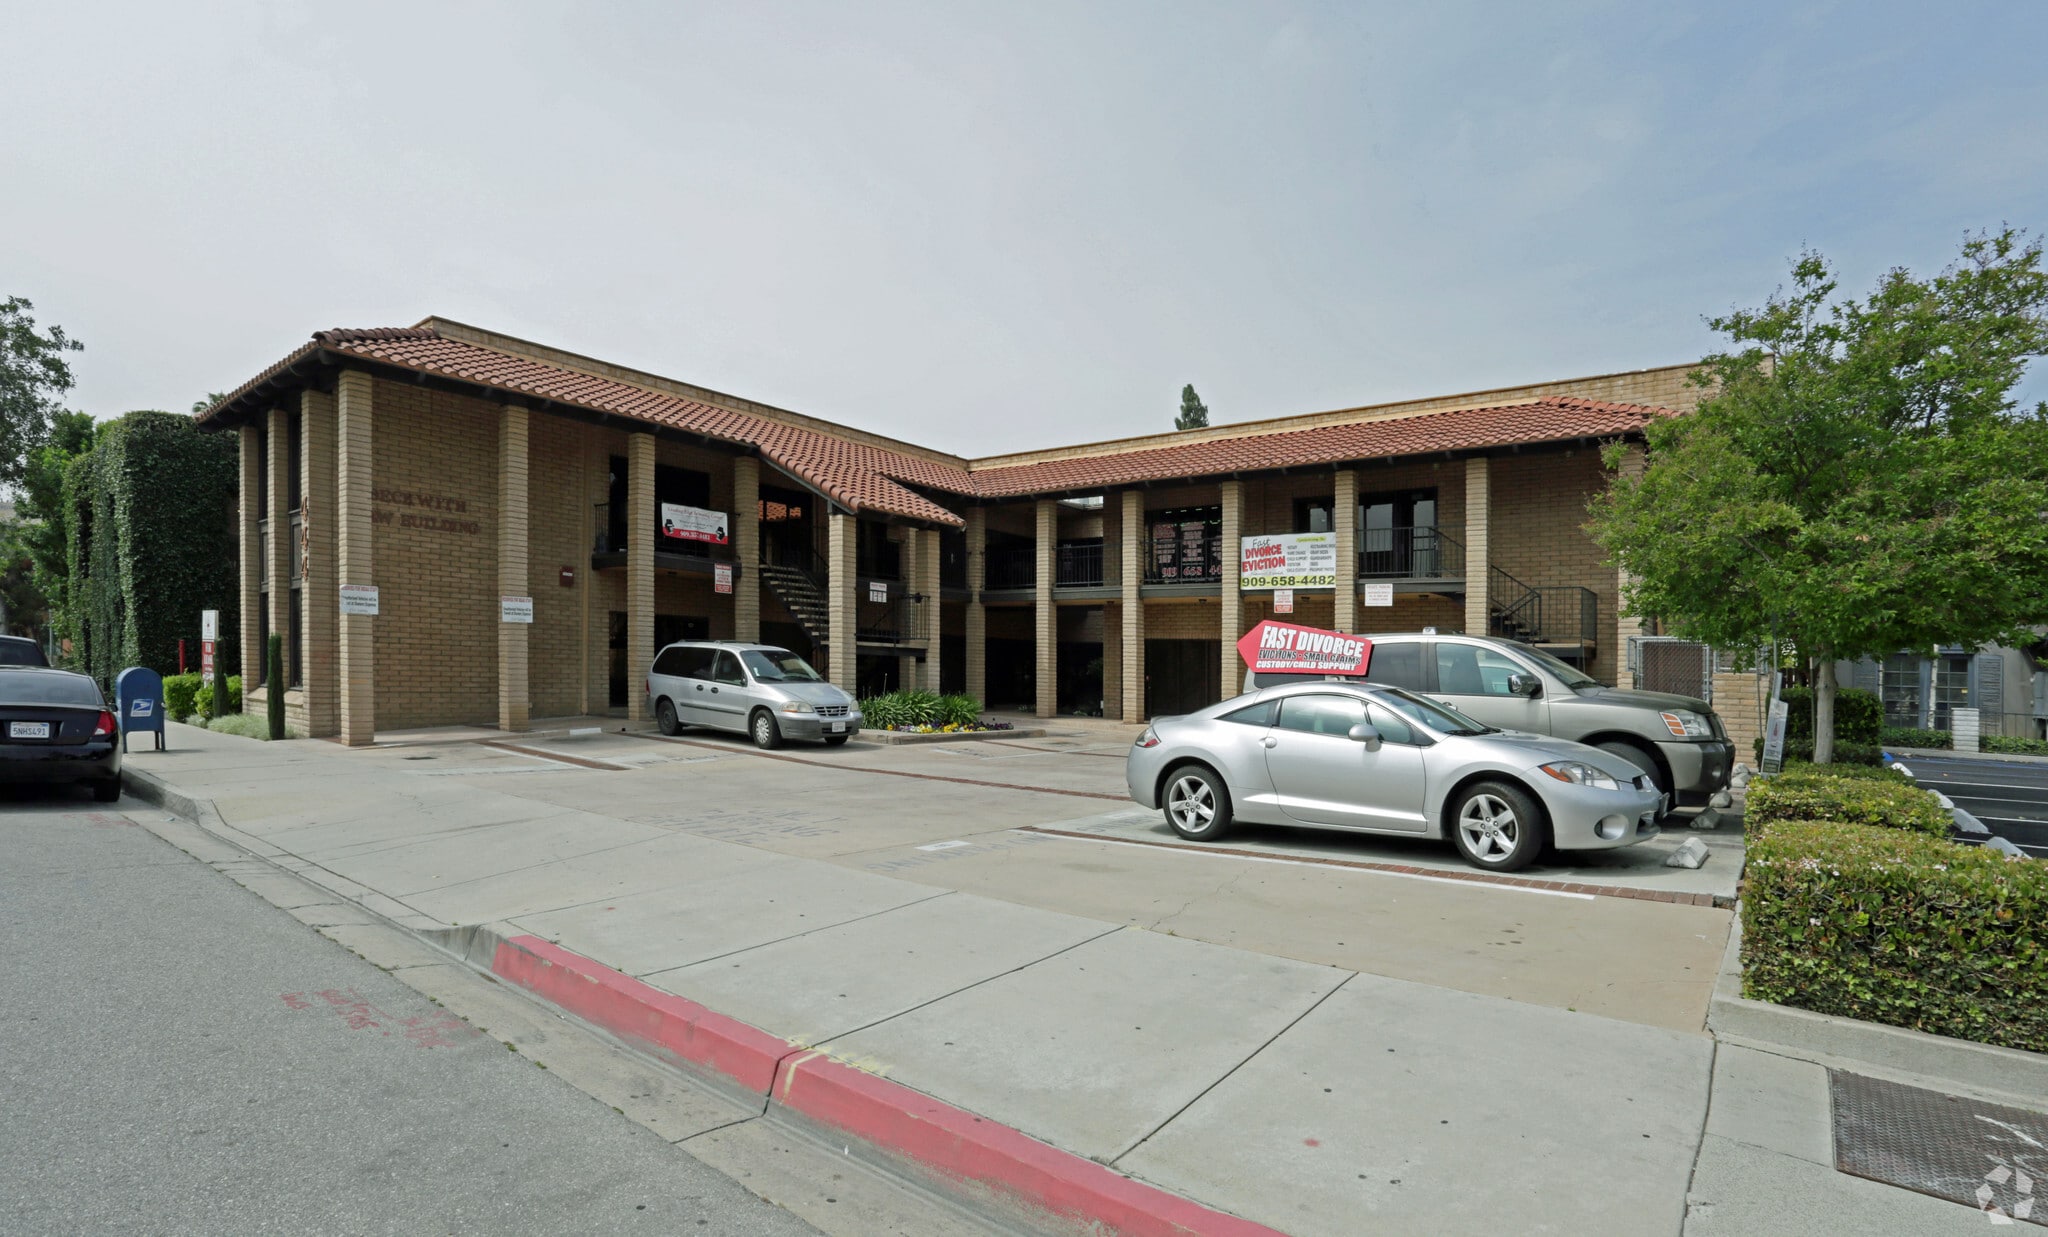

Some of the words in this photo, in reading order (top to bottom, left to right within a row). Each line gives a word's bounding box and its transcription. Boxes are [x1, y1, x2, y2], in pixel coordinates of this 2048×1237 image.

[1252, 538, 1271, 548] Fast
[1245, 544, 1282, 559] DIVORCE
[1242, 556, 1286, 573] EVICTION
[1242, 575, 1335, 587] 909-658-4482
[1259, 625, 1297, 650] FAST
[1296, 631, 1365, 657] DIVORCE
[1258, 649, 1297, 660] EVICTIONS
[1303, 652, 1328, 662] SMALL
[1330, 653, 1362, 665] CLAIMS
[1256, 660, 1317, 669] CUSTODY/CHILD
[1317, 661, 1357, 671] SUPPORT
